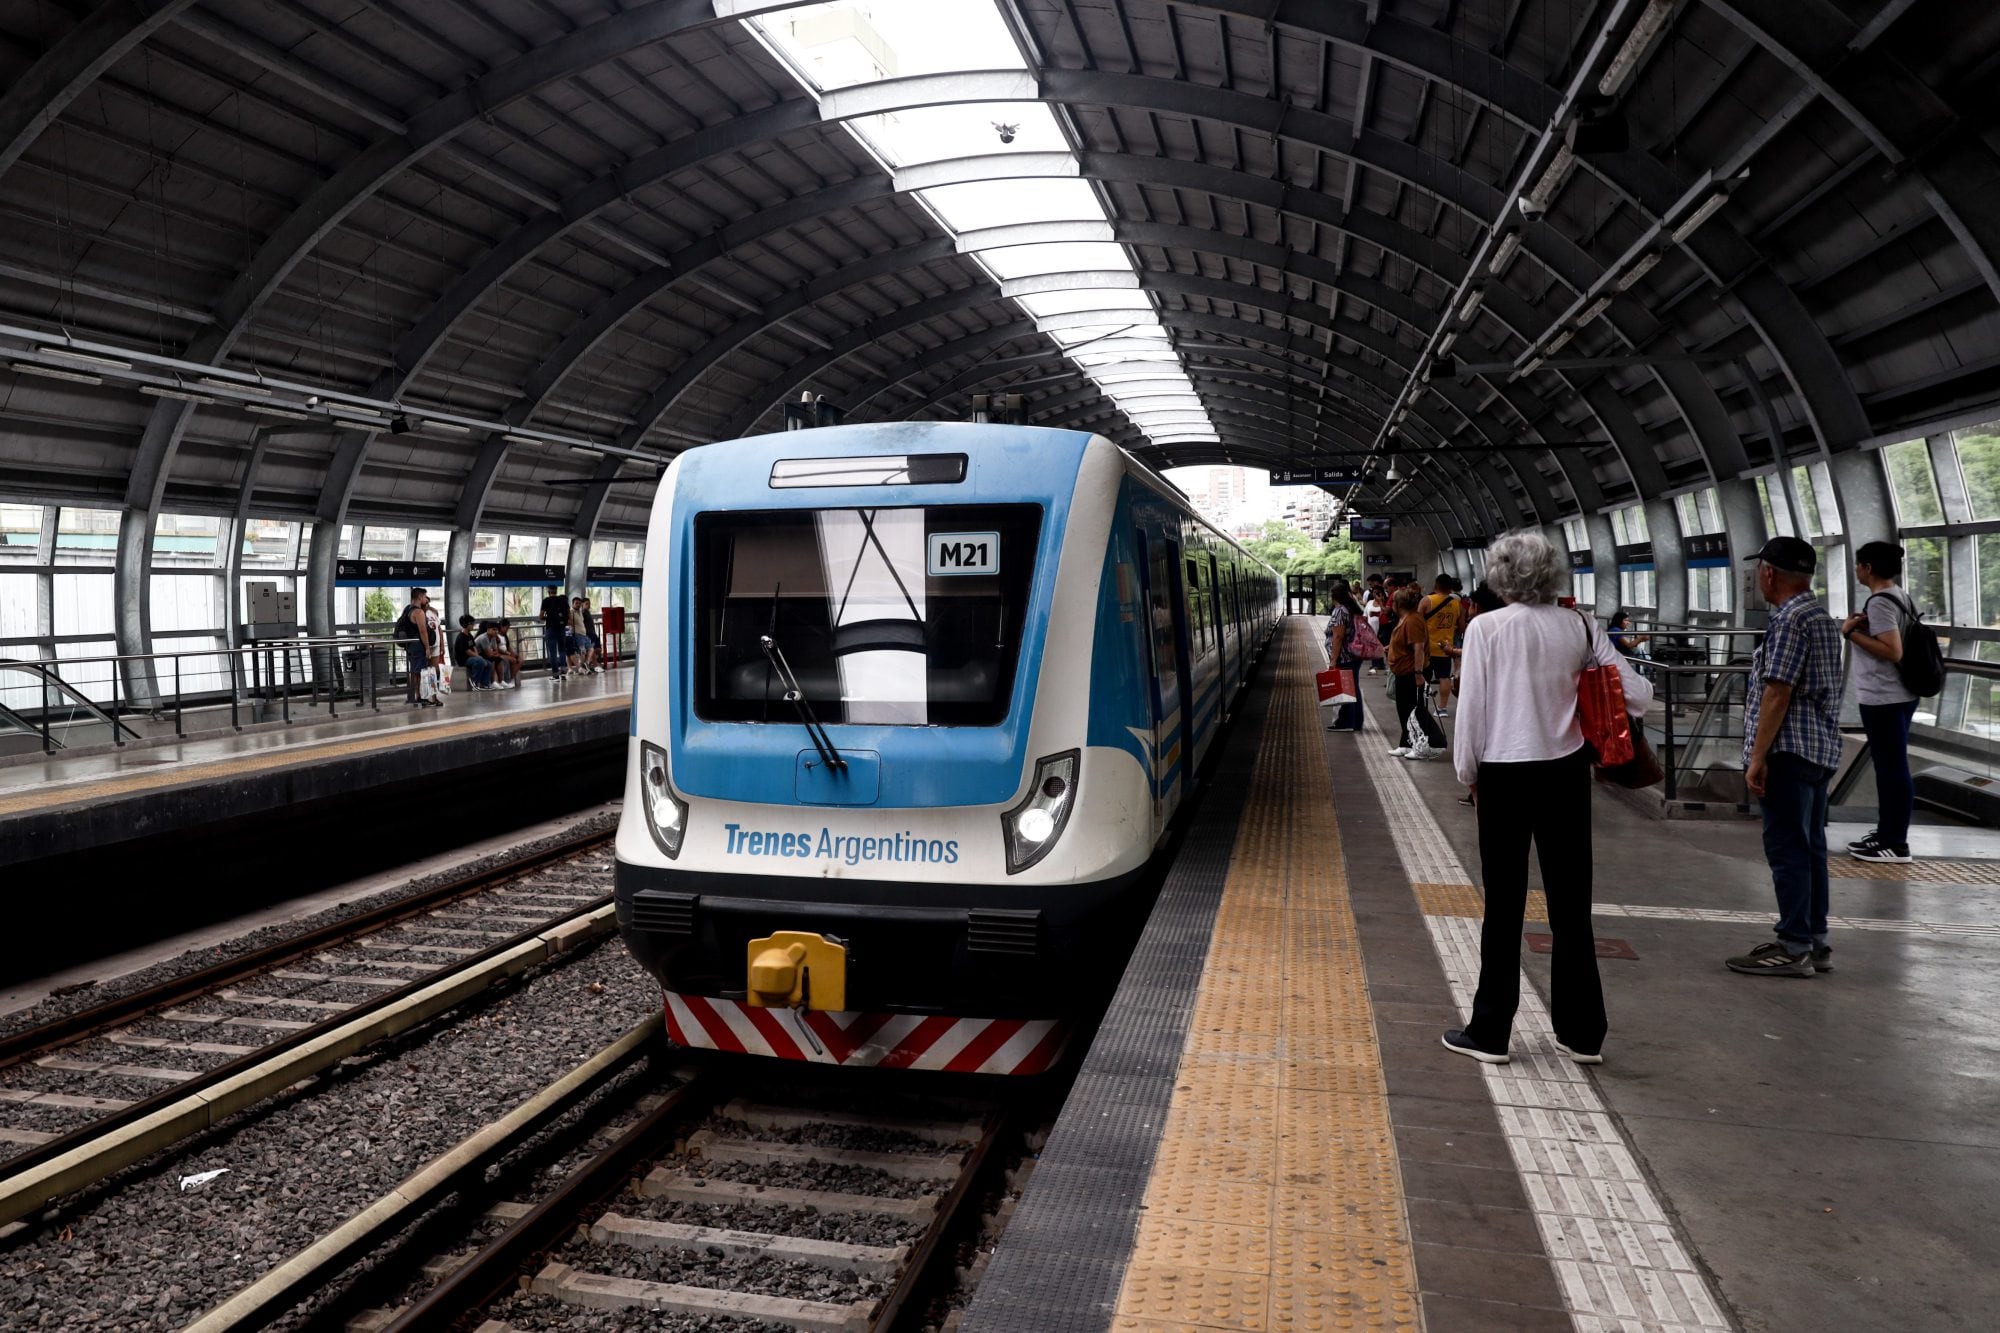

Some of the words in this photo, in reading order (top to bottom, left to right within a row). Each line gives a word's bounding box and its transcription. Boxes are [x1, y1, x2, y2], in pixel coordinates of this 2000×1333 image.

[940, 542, 988, 568] M21
[724, 824, 811, 858] Trenes
[815, 827, 958, 866] Argentinos
